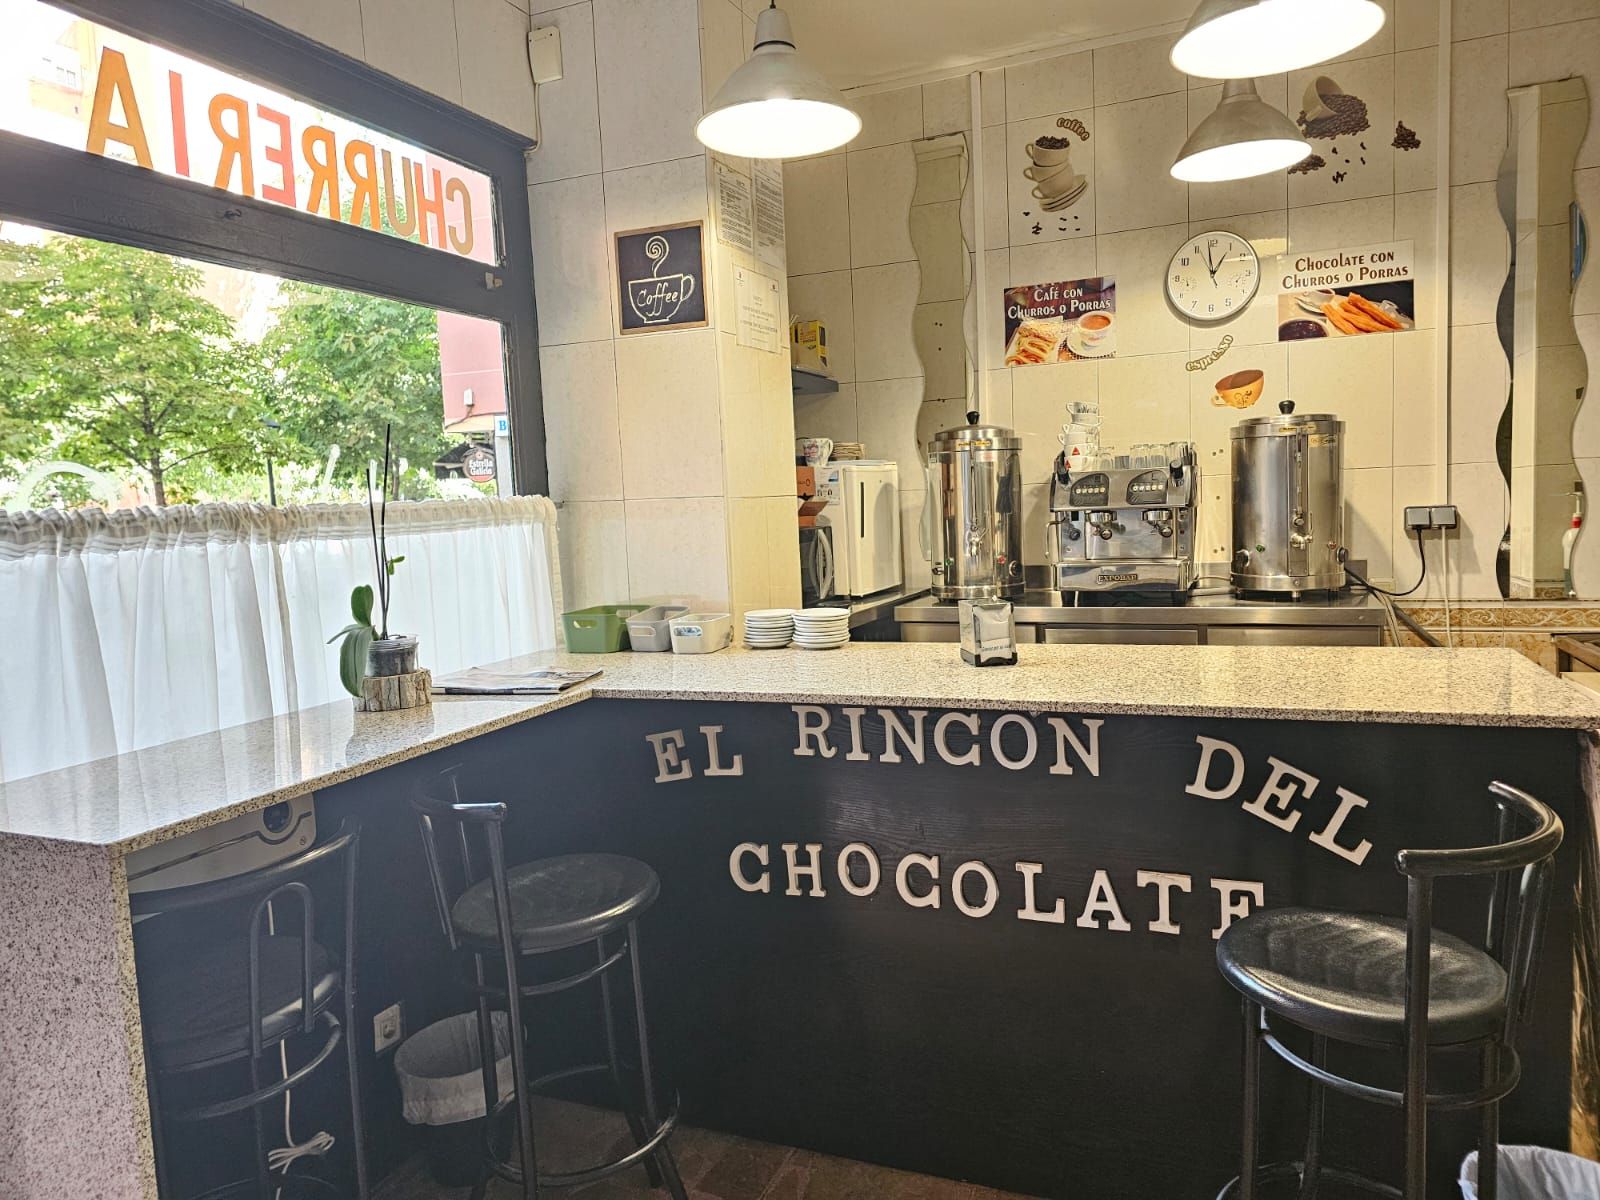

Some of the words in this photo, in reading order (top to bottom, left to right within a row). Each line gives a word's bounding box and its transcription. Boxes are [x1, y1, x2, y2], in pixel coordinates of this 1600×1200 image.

[1056, 117, 1090, 141] coffee
[636, 281, 679, 317] Coffee
[1185, 334, 1234, 371] espresso
[645, 725, 743, 784] EL
[791, 705, 1104, 777] RINCON
[1184, 734, 1373, 866] DEL
[729, 841, 1265, 940] CHOCOLATE
